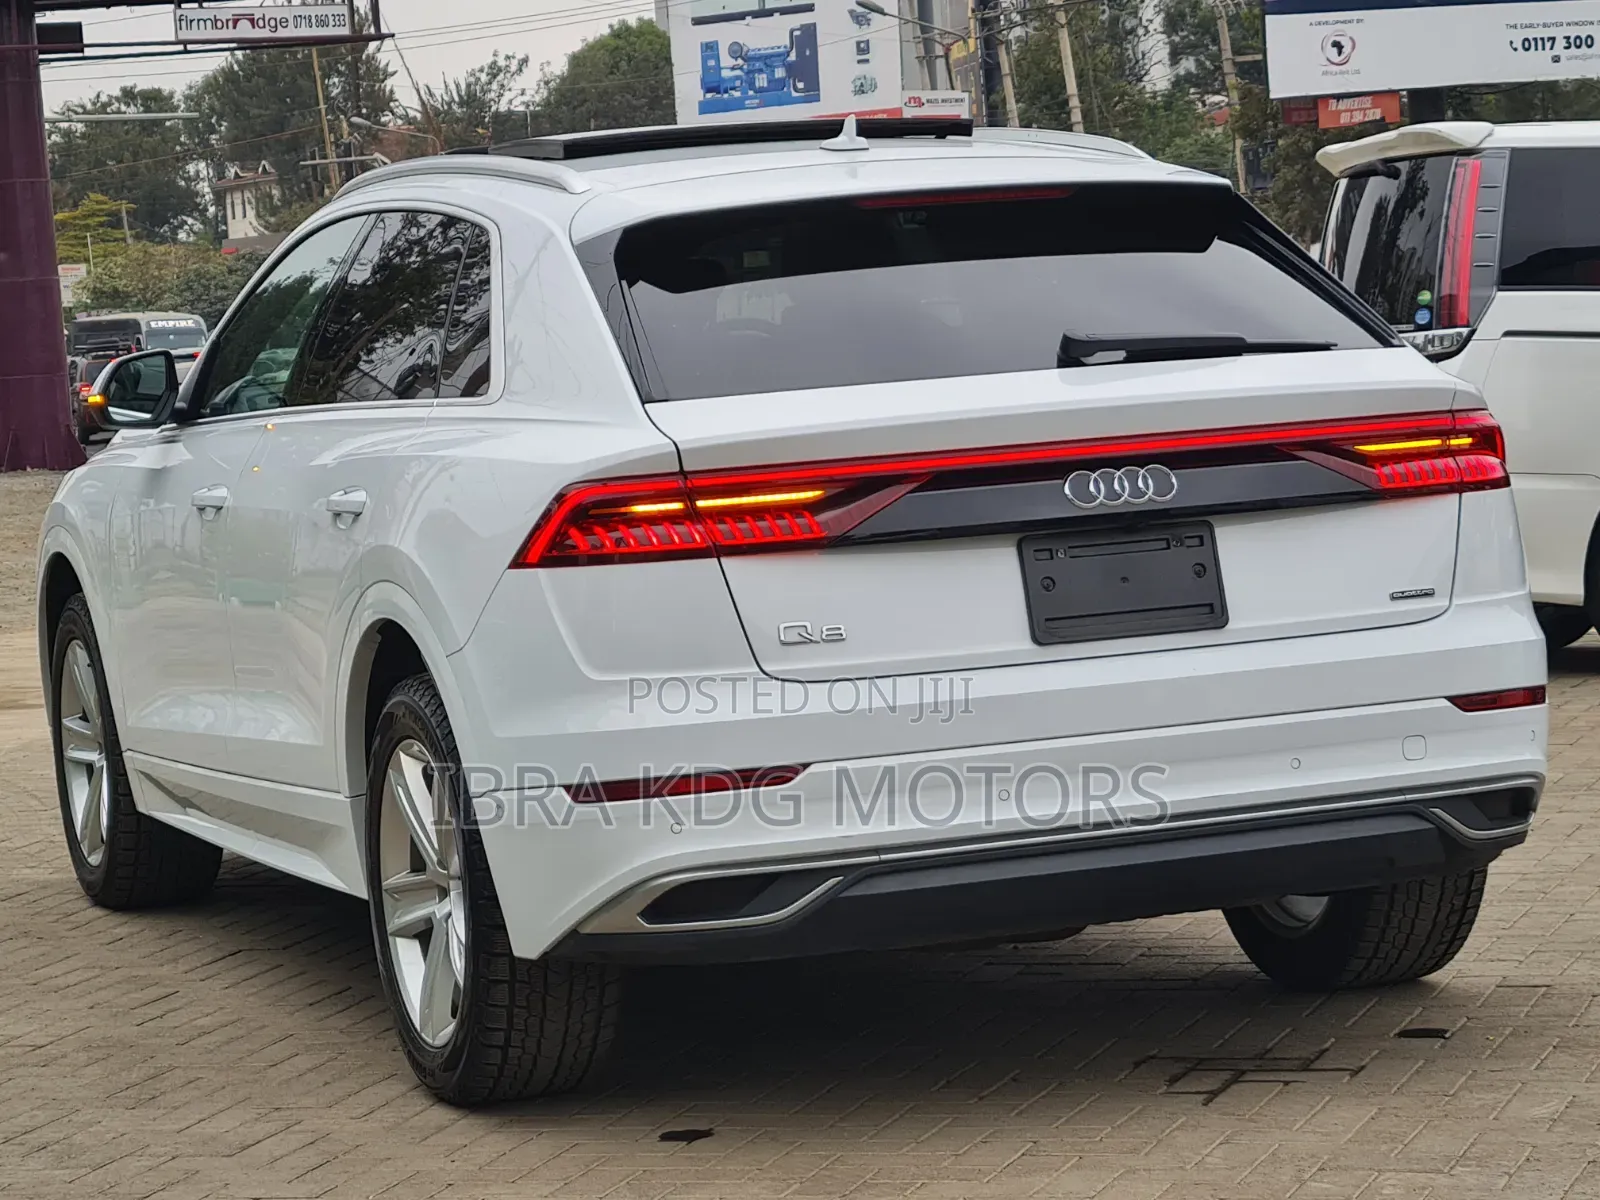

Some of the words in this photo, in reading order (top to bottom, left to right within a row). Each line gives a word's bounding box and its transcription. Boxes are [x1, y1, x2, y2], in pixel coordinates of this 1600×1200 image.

[292, 14, 313, 29] 0718
[314, 14, 329, 28] 860
[331, 13, 347, 28] 333
[1519, 21, 1563, 29] EARLY-BUYER
[1521, 36, 1556, 52] 0117
[1562, 34, 1594, 50] 300
[1337, 95, 1373, 110] ADVERTISE
[150, 319, 195, 328] EMPIRE
[1392, 589, 1434, 598] quattro
[778, 620, 847, 646] Q8
